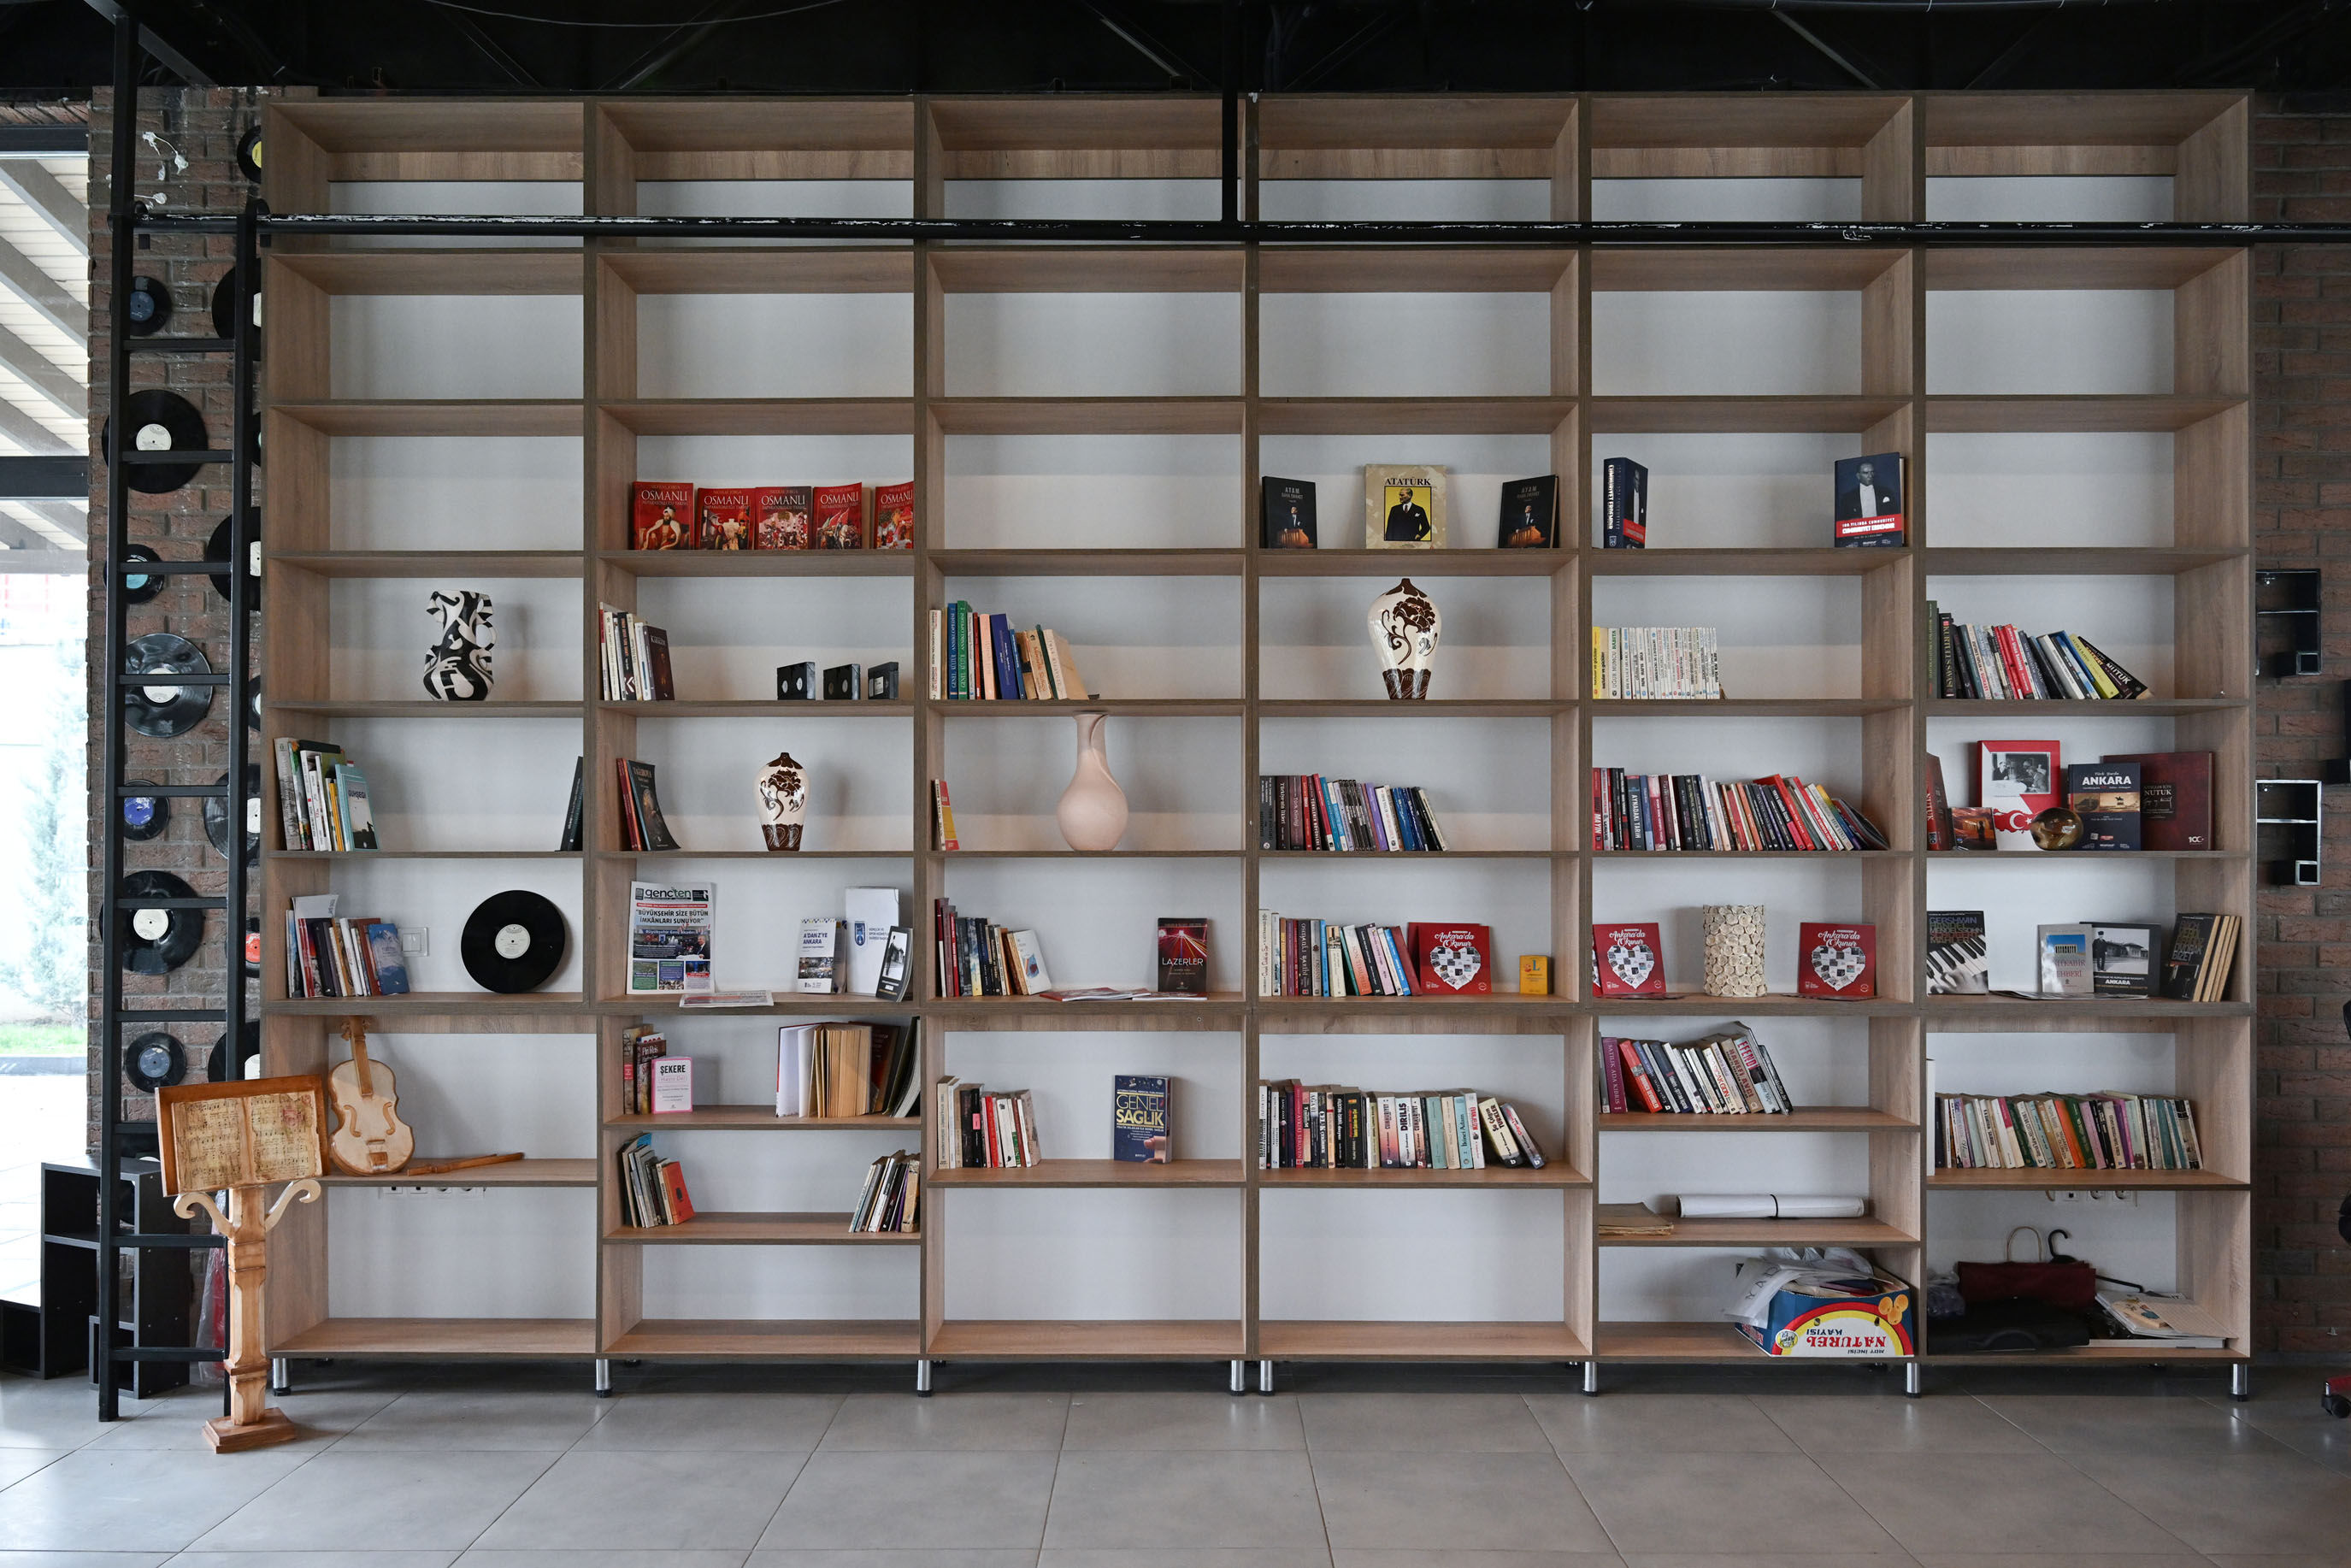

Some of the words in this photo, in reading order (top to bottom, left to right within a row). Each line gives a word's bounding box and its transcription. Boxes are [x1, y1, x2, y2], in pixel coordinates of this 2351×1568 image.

[1384, 476, 1431, 486] ATATÜRK
[641, 491, 687, 501] OSMANLI
[704, 496, 749, 505] OSMANLI
[762, 495, 805, 505] OSMANLI
[821, 492, 858, 504] OSMANLI
[881, 491, 913, 504] OSMANLI
[2107, 659, 2130, 687] NUTUK
[2083, 776, 2131, 785] ANKARA
[1435, 931, 1475, 943] Ankara'da
[1817, 930, 1860, 941] Ankara'da
[1162, 957, 1204, 966] LAZERLER
[1606, 1044, 1617, 1068] SATILIK
[1737, 1040, 1759, 1070] EFENDİ
[660, 1064, 686, 1076] ŞEKERE
[1729, 1049, 1745, 1077] HANEFİ
[1741, 1077, 1754, 1098] AVCI
[1611, 1083, 1623, 1105] KIBRIS
[1117, 1094, 1164, 1111] GENEL
[1806, 1336, 1886, 1347] NATUREL
